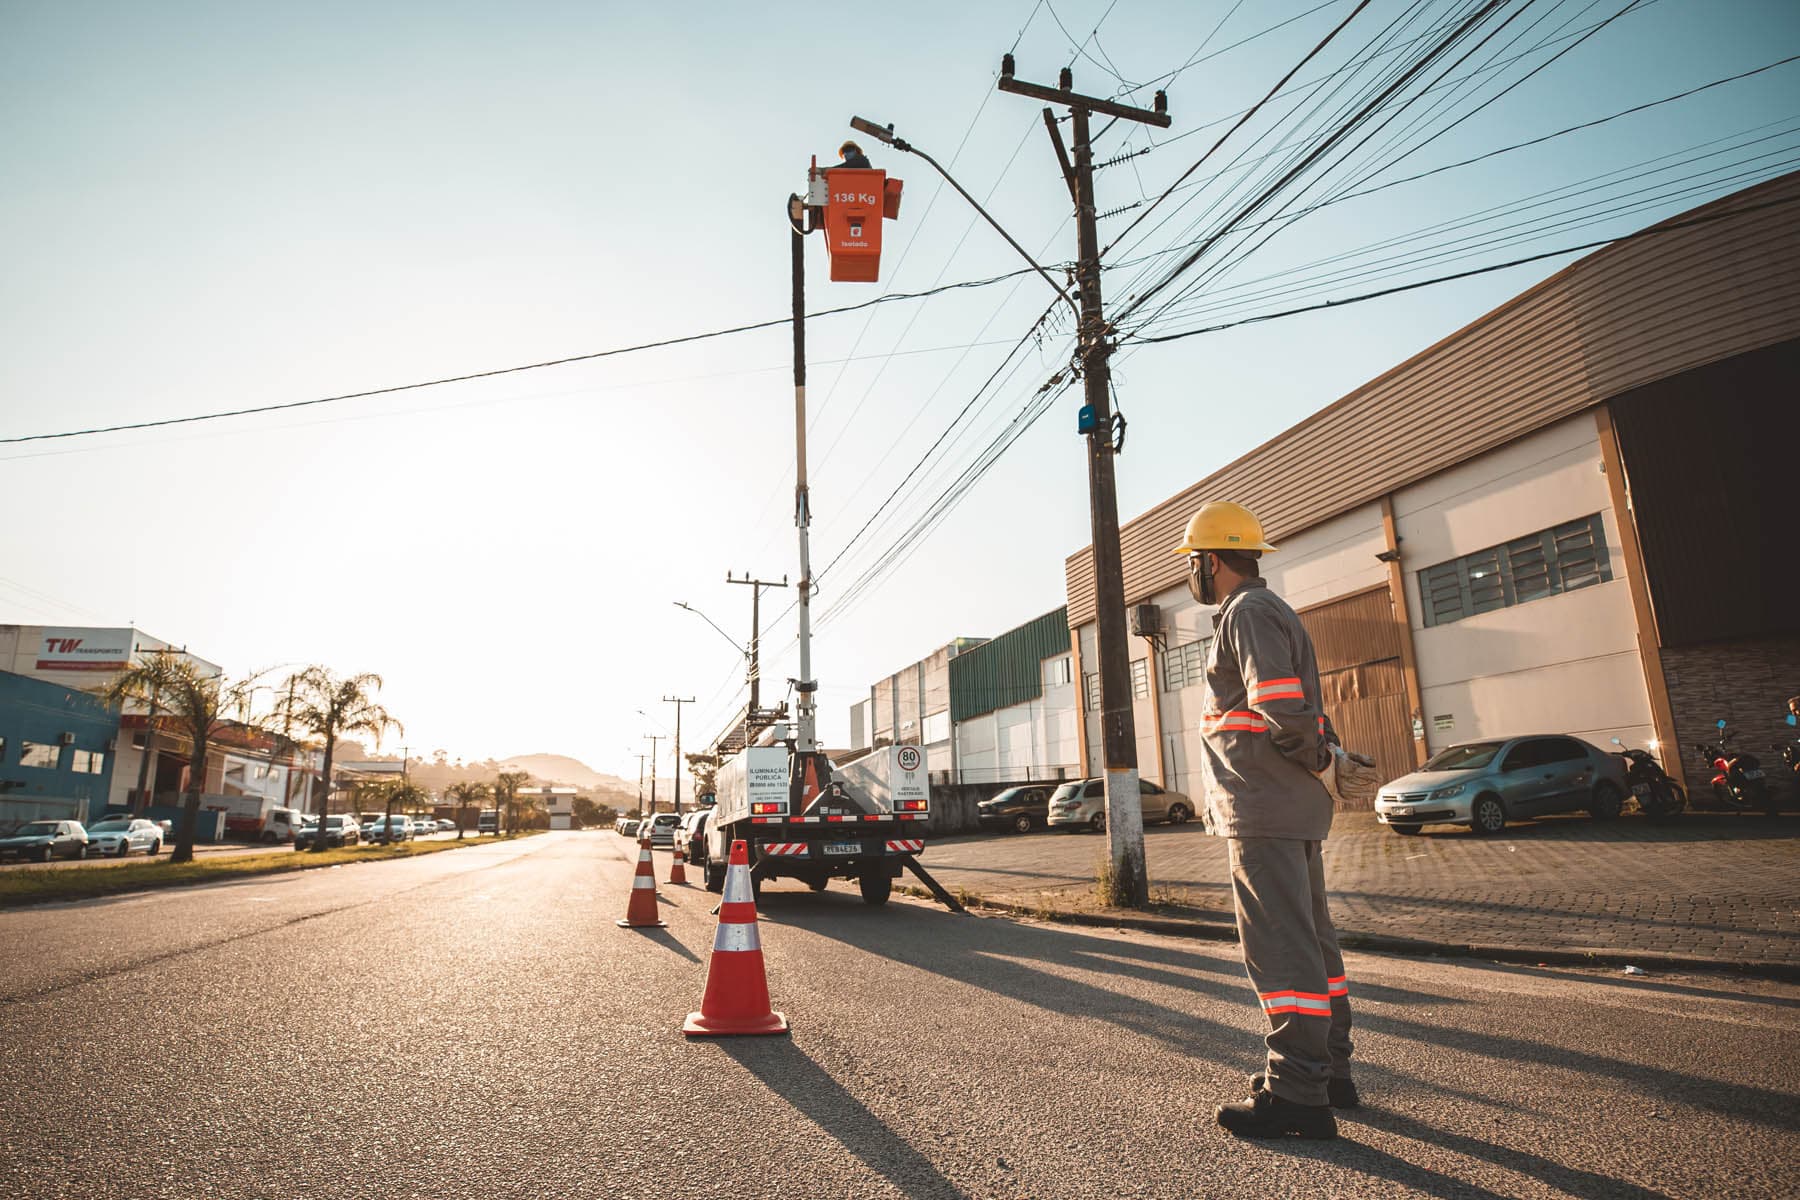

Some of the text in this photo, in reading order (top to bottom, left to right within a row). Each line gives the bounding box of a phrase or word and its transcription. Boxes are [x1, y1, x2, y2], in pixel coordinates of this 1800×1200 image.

[834, 193, 876, 205] 136 Kg
[45, 638, 83, 653] TW
[902, 751, 916, 761] 80
